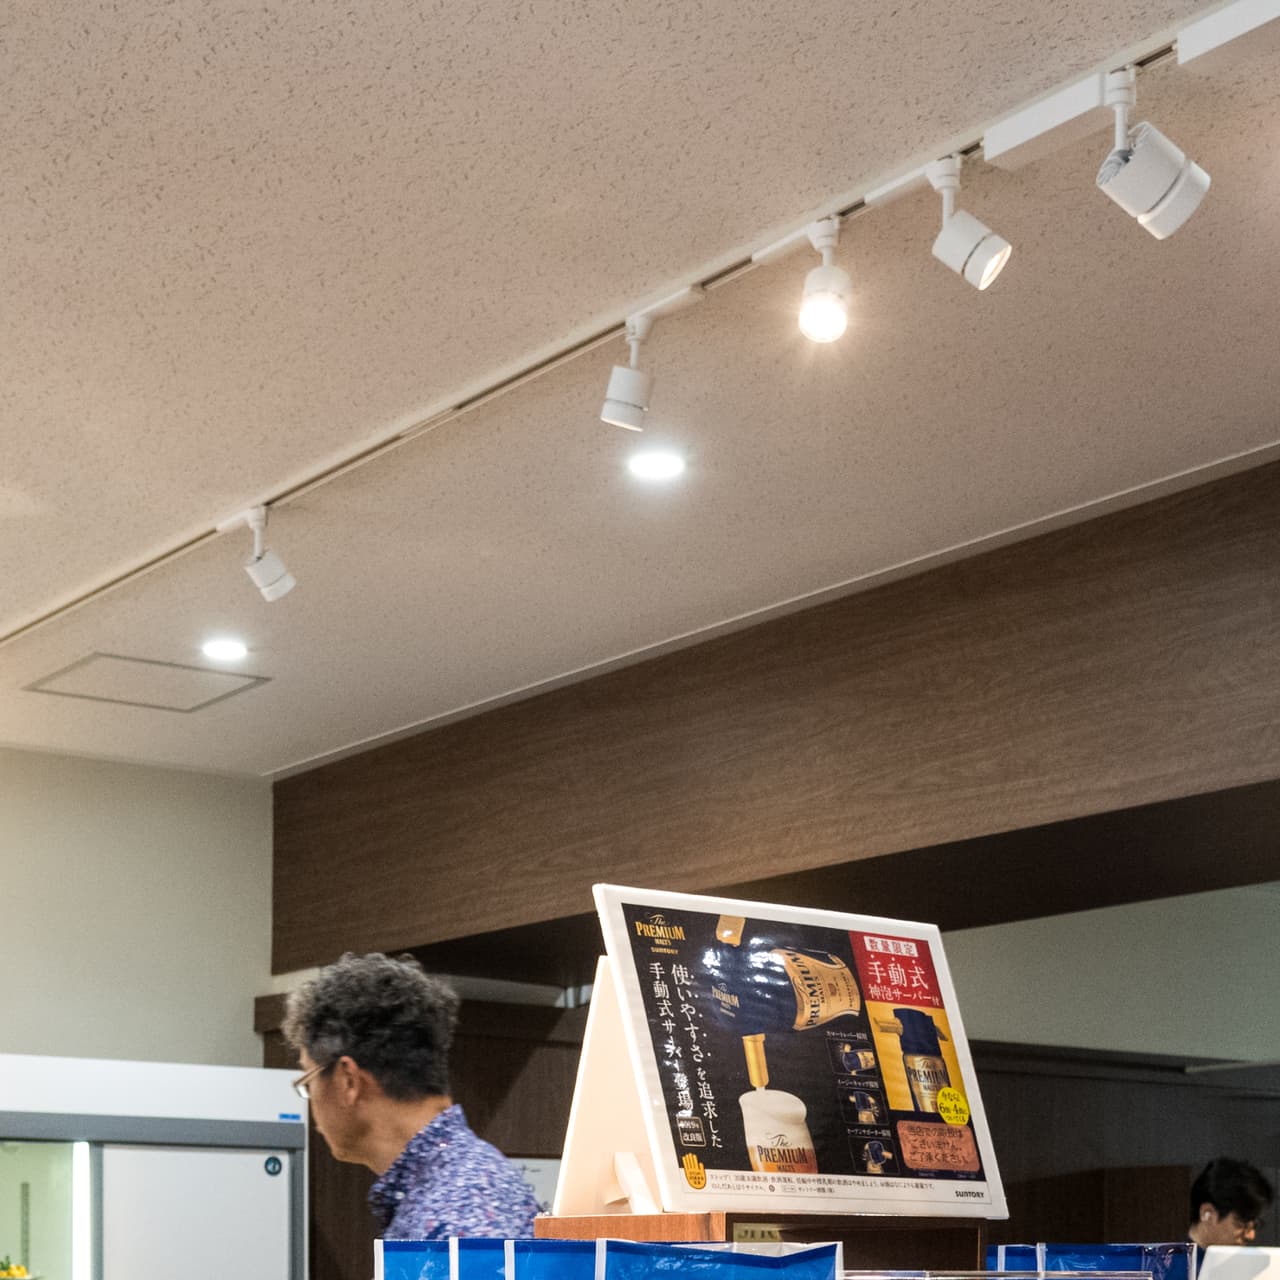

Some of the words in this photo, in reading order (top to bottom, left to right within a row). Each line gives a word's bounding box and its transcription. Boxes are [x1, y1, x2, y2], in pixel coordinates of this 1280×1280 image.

[635, 921, 686, 941] PREMIUM
[868, 961, 929, 990] 手動式
[868, 984, 940, 1006] 神泡サーバー付
[671, 963, 723, 1148] 使いやすさを追求した
[757, 1144, 808, 1163] PREMIUM
[955, 1190, 984, 1198] SUNTORY
